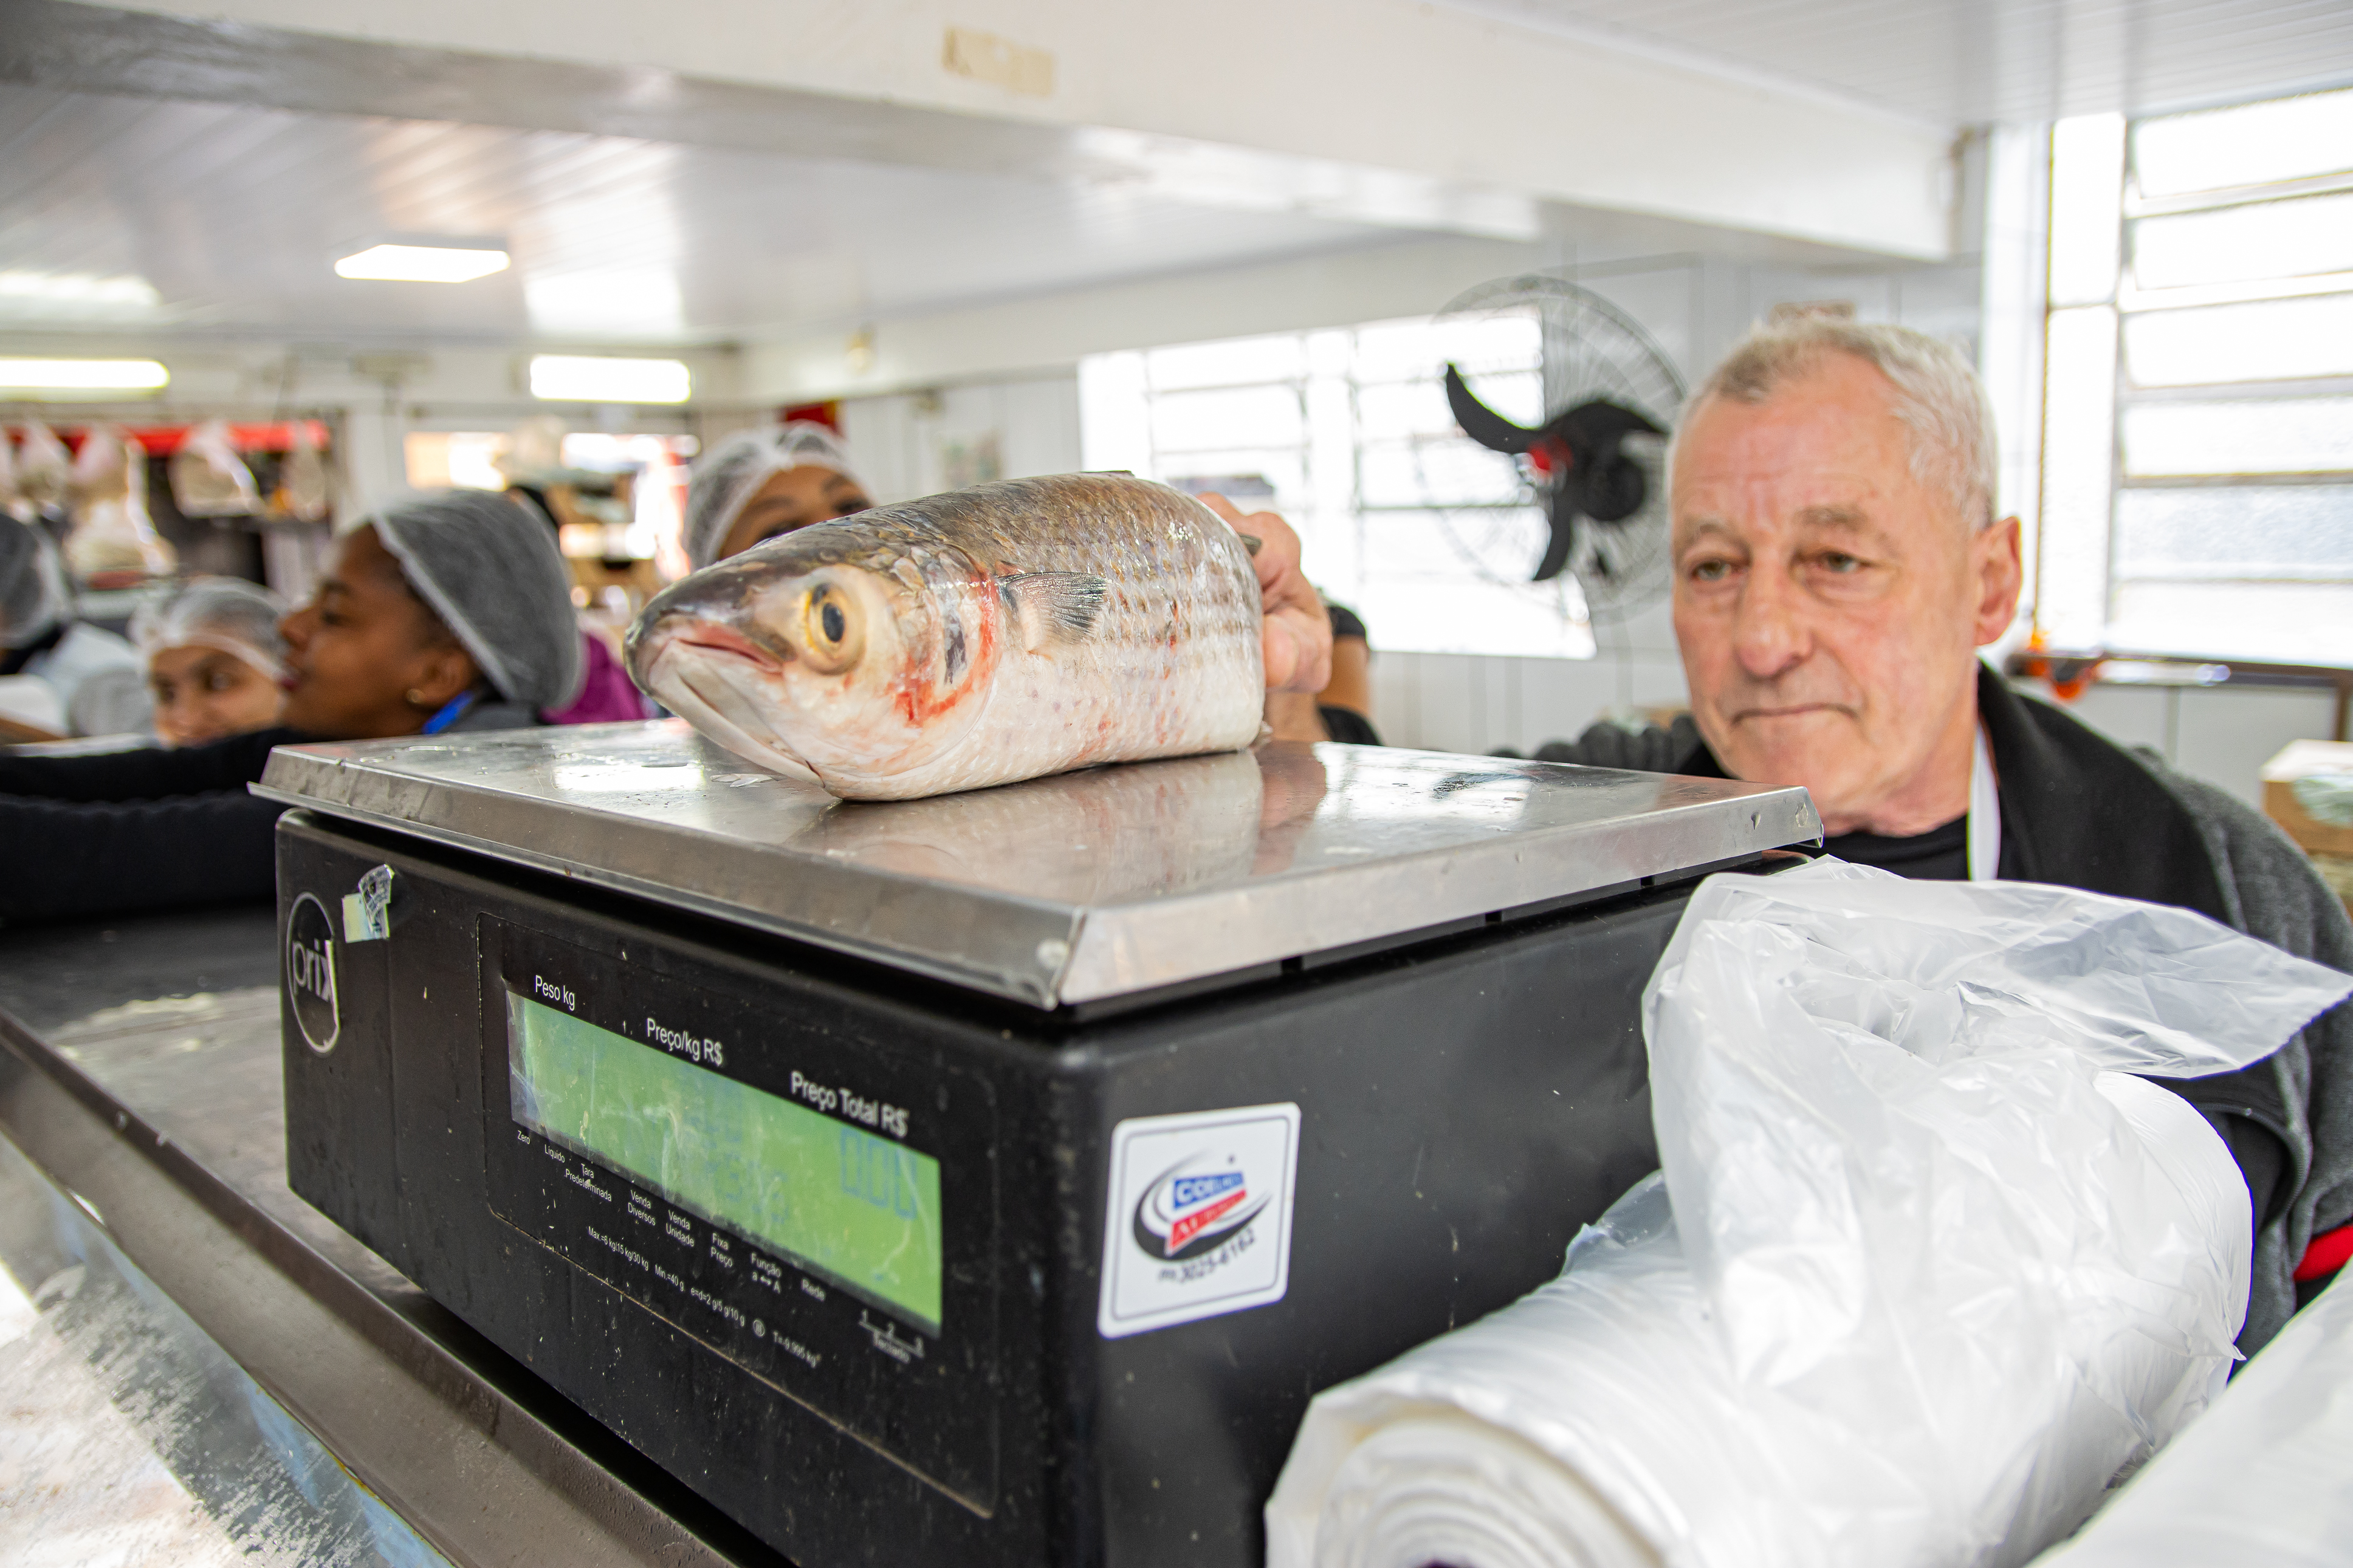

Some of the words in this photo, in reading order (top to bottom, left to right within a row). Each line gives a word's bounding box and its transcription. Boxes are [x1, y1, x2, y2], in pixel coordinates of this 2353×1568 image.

[535, 974, 560, 1001] Peso
[563, 985, 575, 1011] kg
[647, 1017, 701, 1061] Preço/kg
[703, 1038, 723, 1066] R$
[791, 1070, 838, 1111] Preço
[839, 1087, 879, 1126] Total
[881, 1103, 910, 1138] R$
[517, 1129, 531, 1145] Zero
[581, 1163, 594, 1179] Tara
[565, 1168, 612, 1202] Predeterminada
[630, 1190, 651, 1210] Venda
[628, 1202, 656, 1226] Diversos
[668, 1210, 690, 1231] Venda
[665, 1223, 695, 1247] Unidade
[712, 1232, 729, 1251] Fixa
[710, 1246, 733, 1268] Preço
[751, 1252, 782, 1278] Função
[625, 1247, 641, 1264] kg/30
[641, 1257, 649, 1271] kg
[679, 1281, 684, 1292] g
[740, 1315, 745, 1327] g
[801, 1278, 826, 1302] Rede
